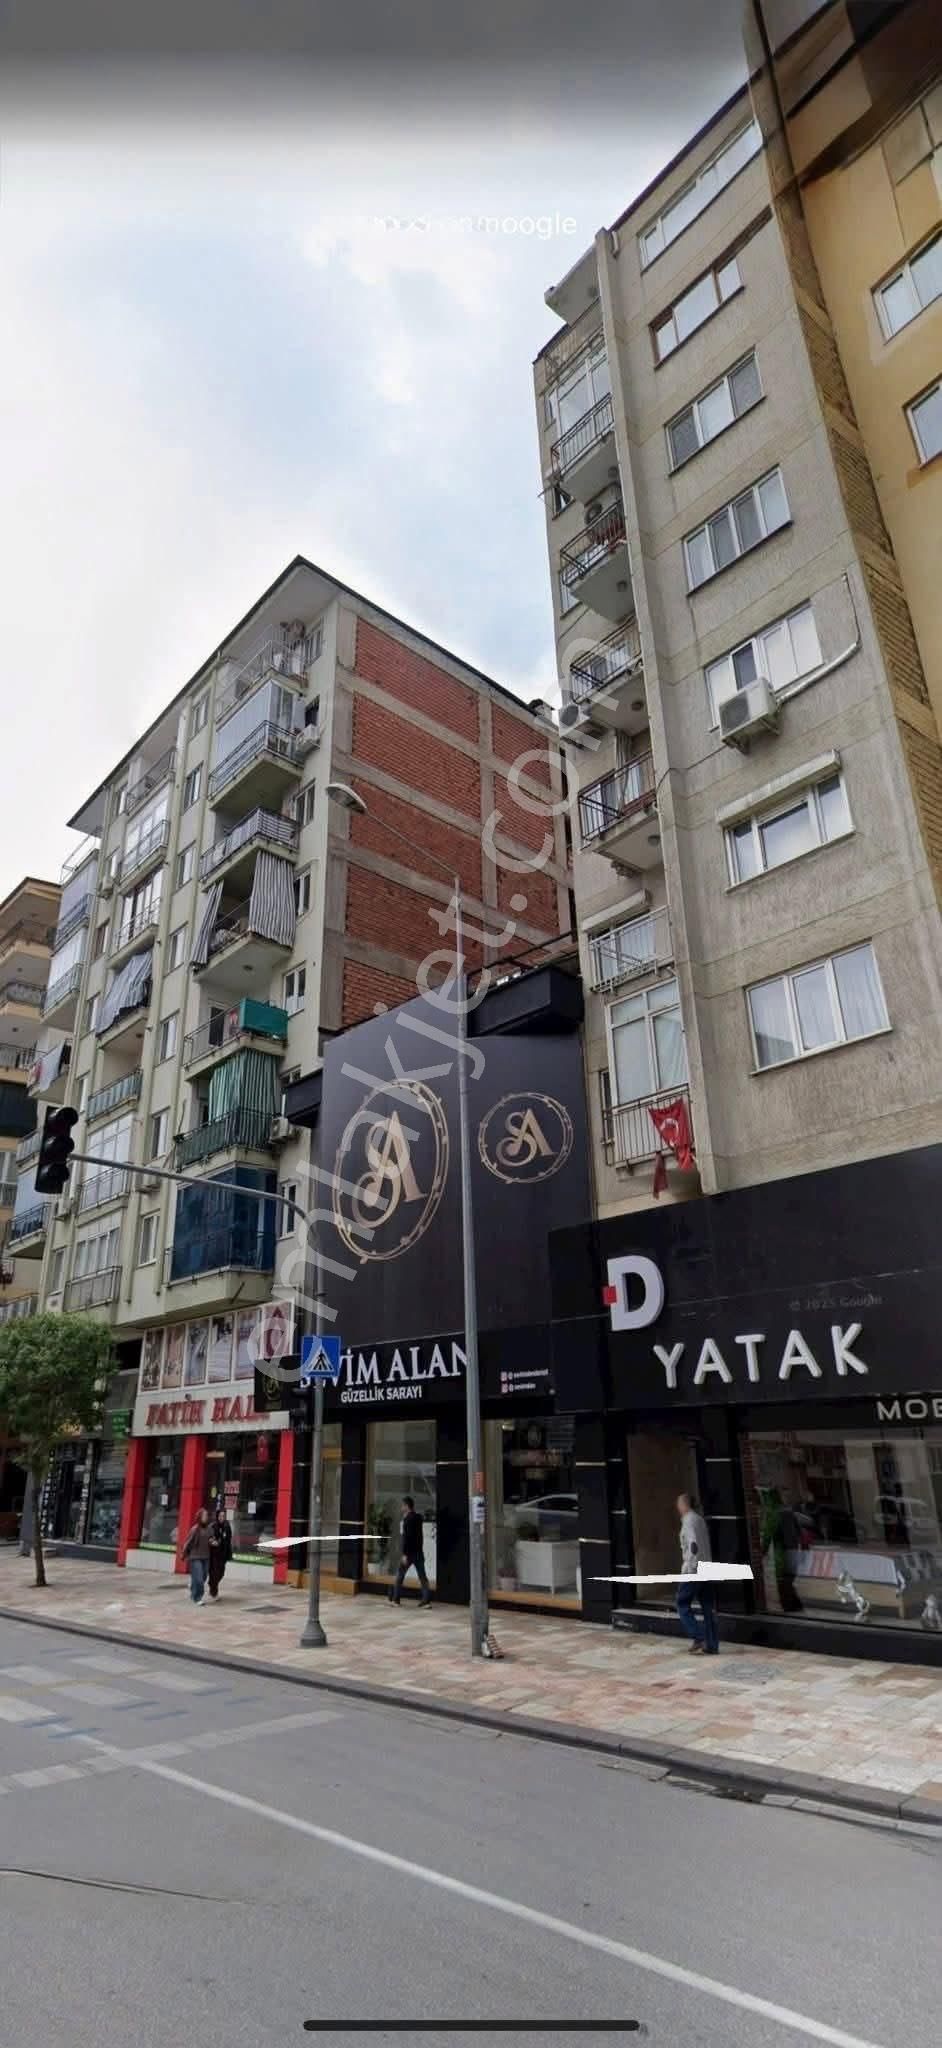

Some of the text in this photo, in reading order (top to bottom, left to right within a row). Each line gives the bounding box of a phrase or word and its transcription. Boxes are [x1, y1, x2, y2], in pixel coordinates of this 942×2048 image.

[653, 1322, 868, 1389] YATAK
[340, 1385, 423, 1404] GÜZELLİK SARAYI
